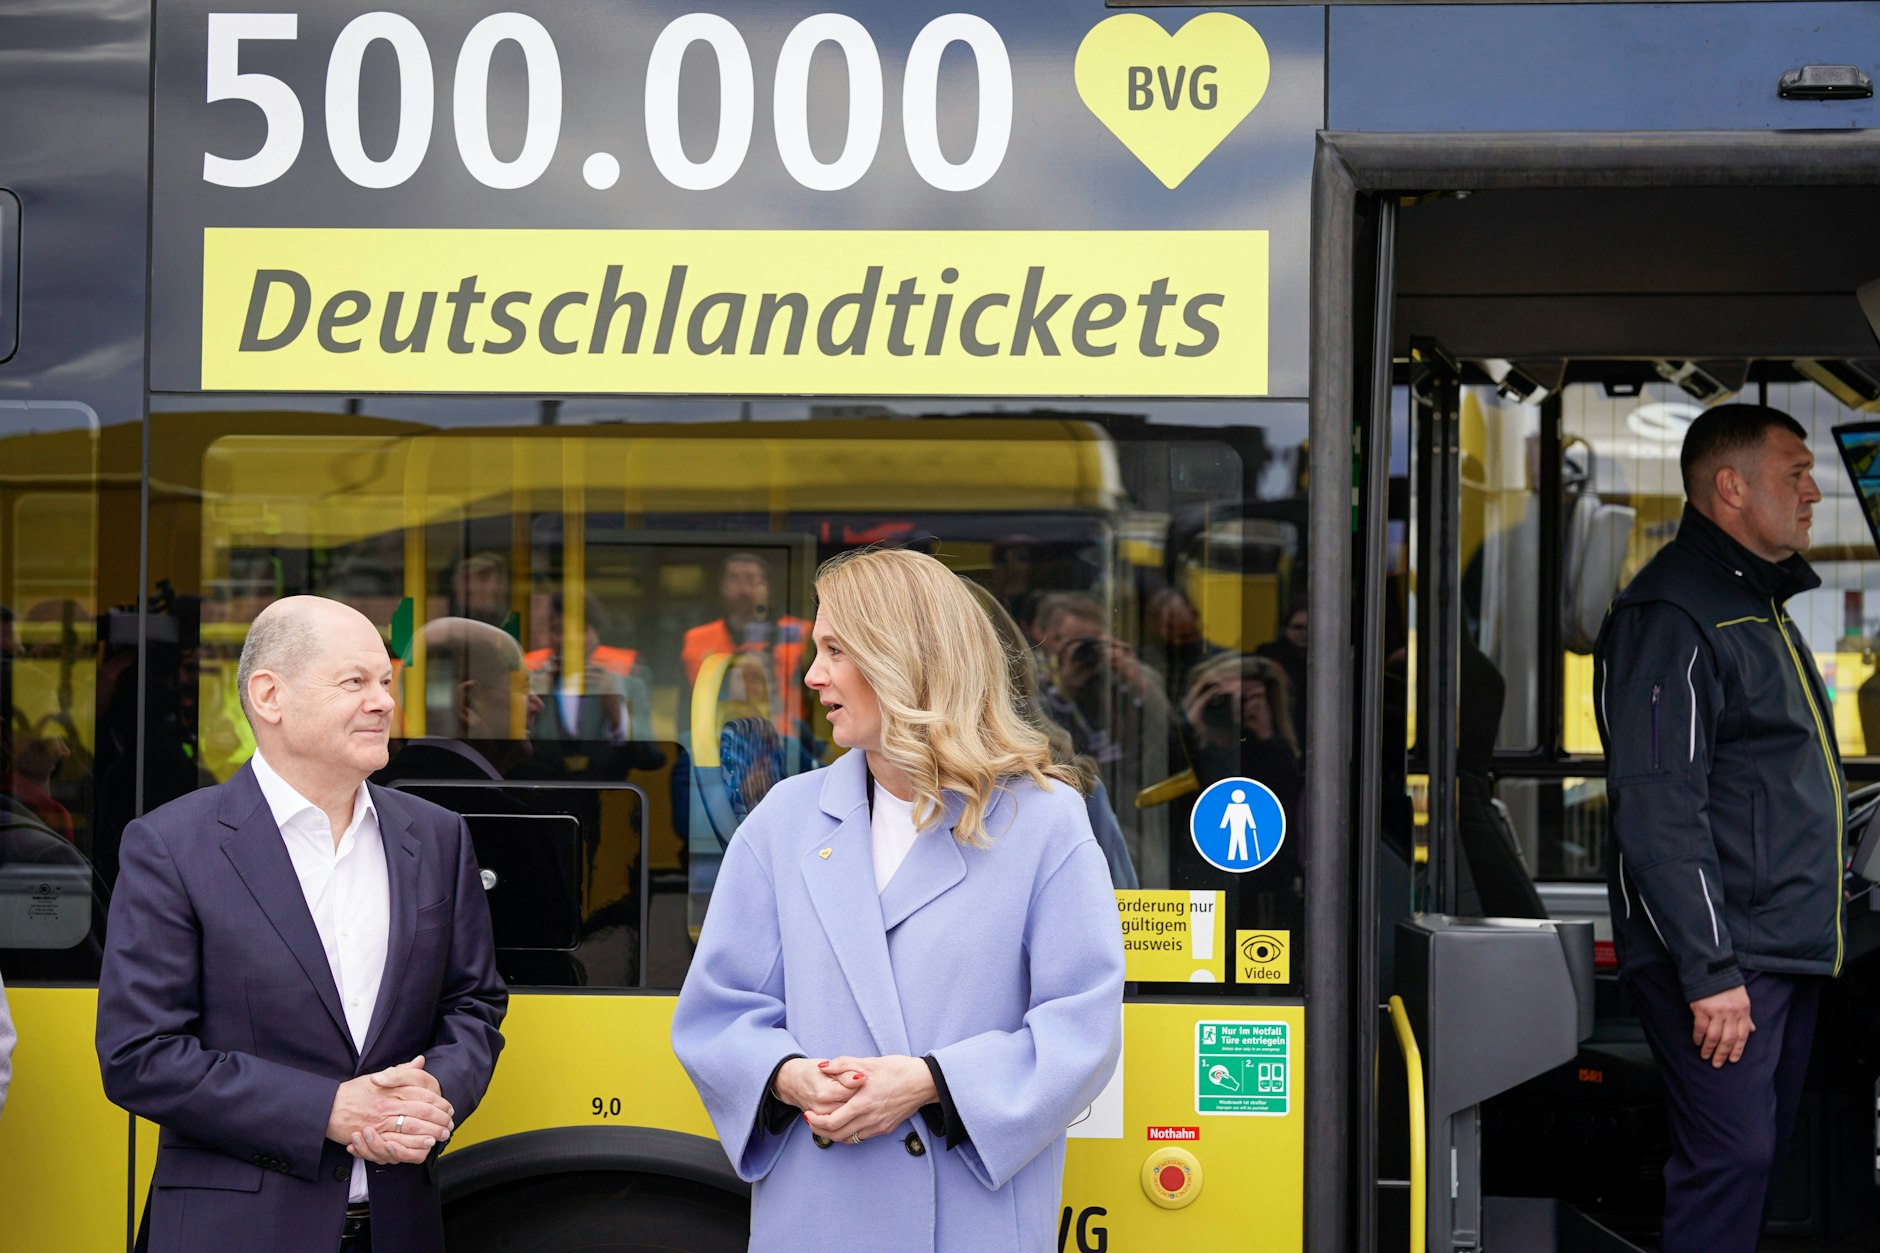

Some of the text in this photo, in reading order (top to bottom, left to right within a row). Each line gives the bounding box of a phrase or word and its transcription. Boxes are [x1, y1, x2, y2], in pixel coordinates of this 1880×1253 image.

[1128, 65, 1218, 111] BVG
[203, 12, 1013, 191] 500.000
[238, 264, 1225, 358] Deutschlandtickets
[1115, 897, 1214, 916] örderung nur
[1121, 917, 1187, 935] gültigem
[1124, 937, 1183, 951] ausweis
[1244, 967, 1281, 979] Video
[1222, 1027, 1282, 1036] Nur im Notfall
[1221, 1036, 1285, 1046] Türe entriegeln
[1201, 1059, 1210, 1067] 1.
[1245, 1060, 1254, 1068] 2.
[592, 1097, 621, 1118] 9,0
[1150, 1128, 1195, 1139] Nothahn
